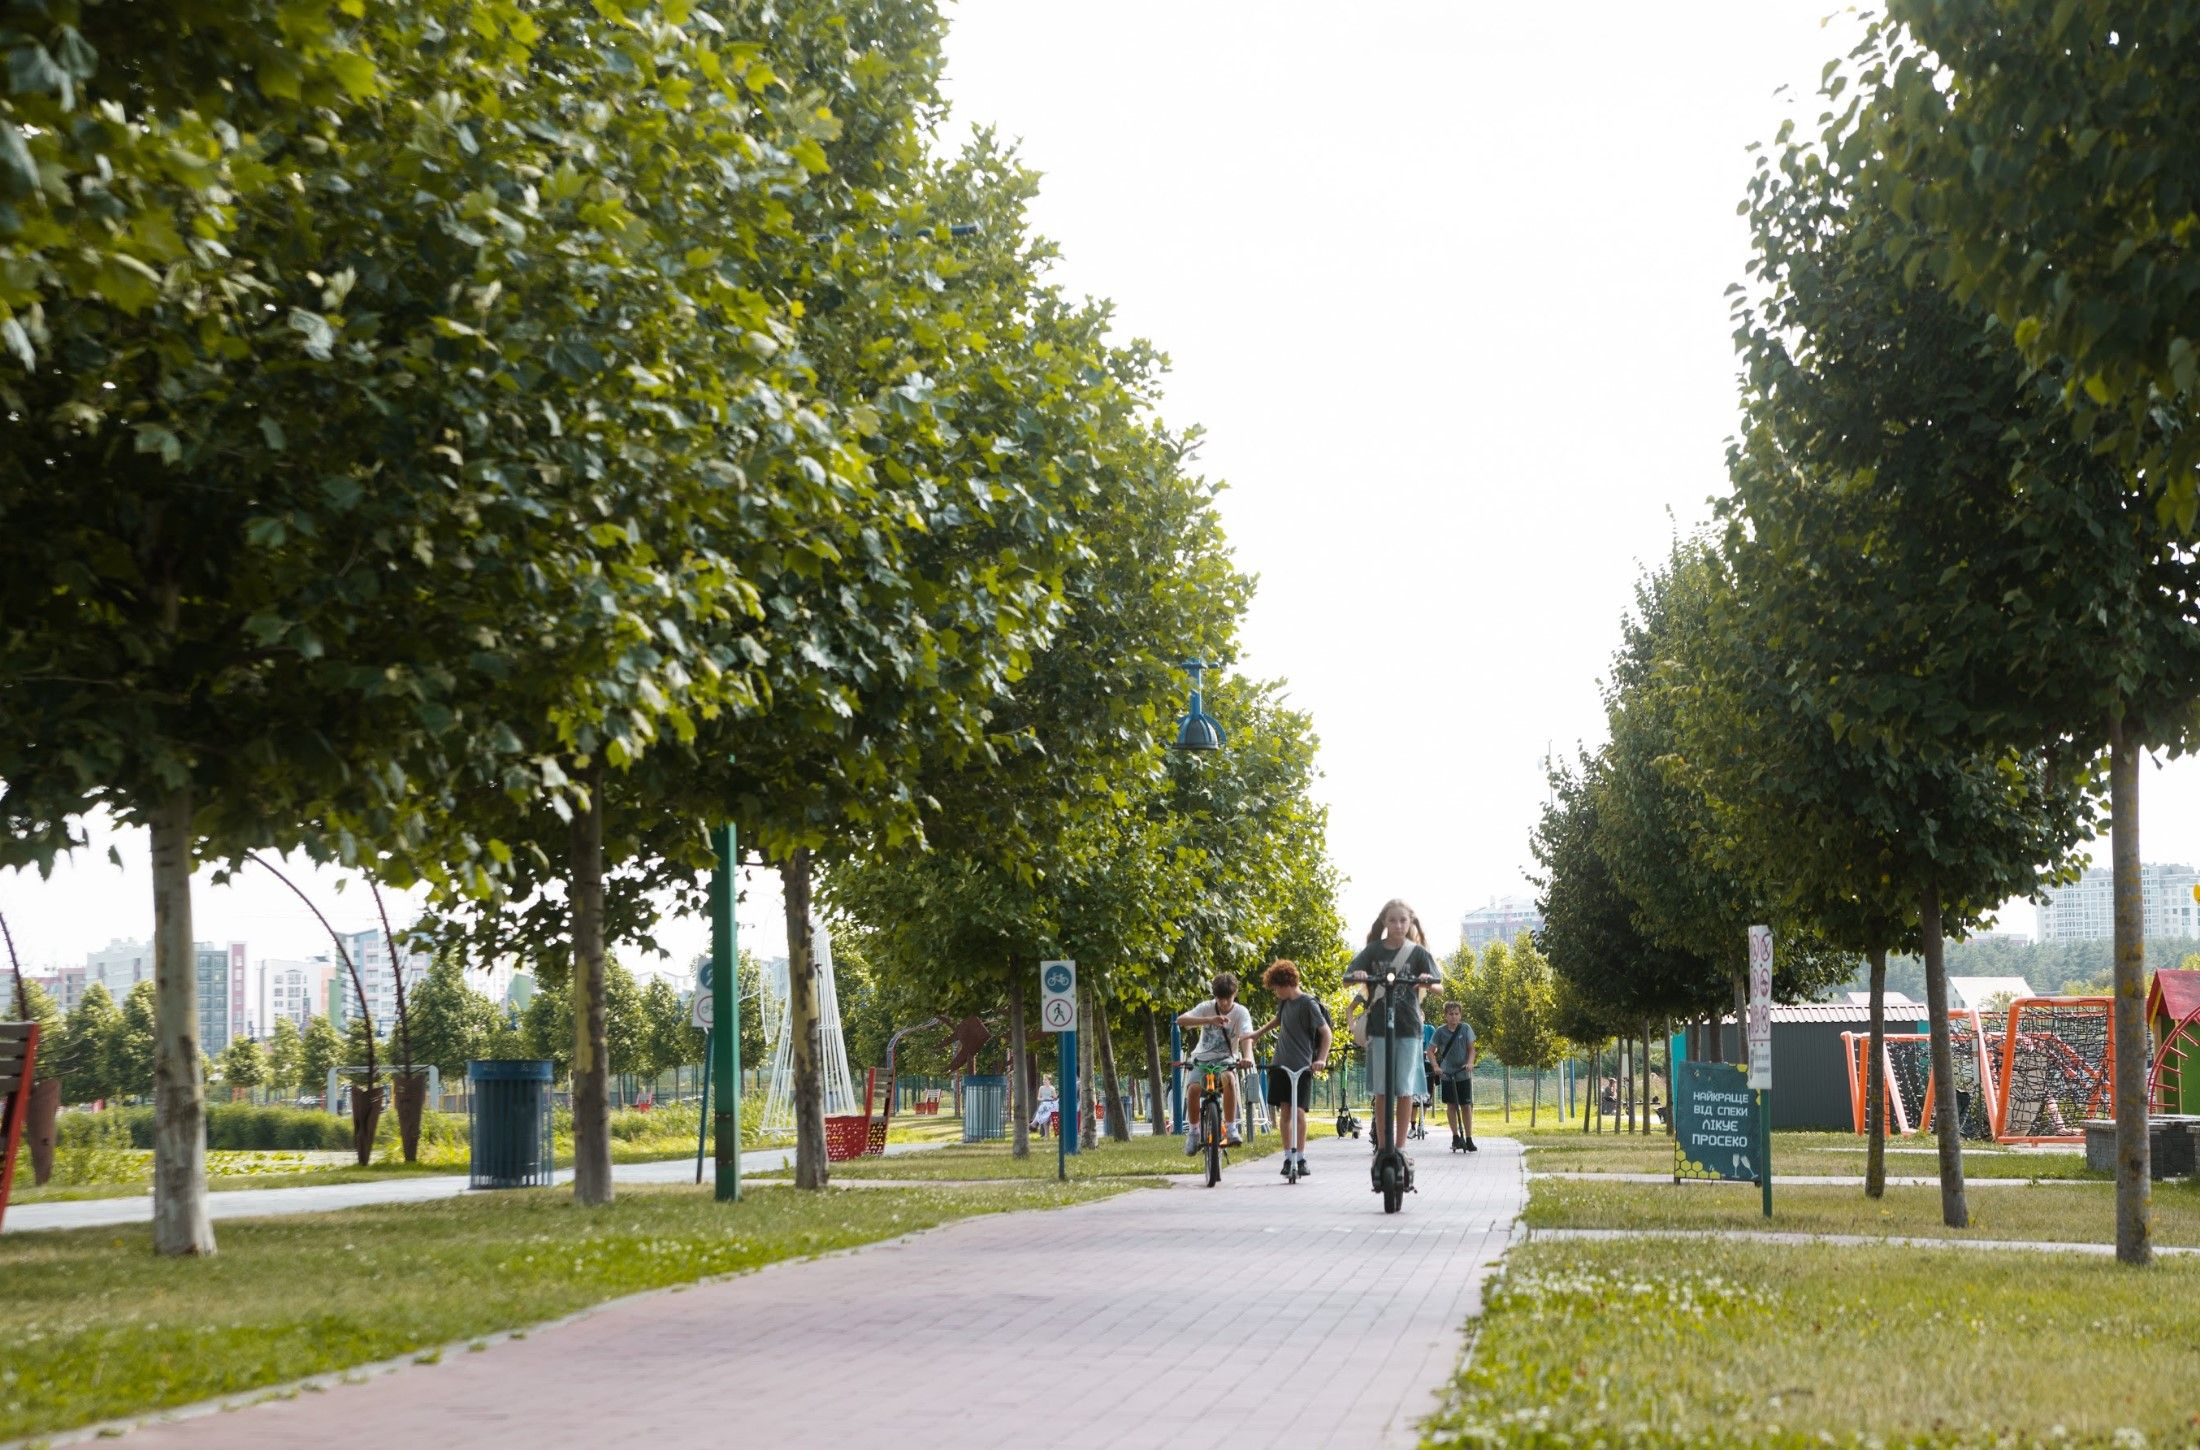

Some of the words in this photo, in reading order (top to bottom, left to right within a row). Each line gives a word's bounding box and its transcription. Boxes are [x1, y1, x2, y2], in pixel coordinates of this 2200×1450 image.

[1693, 1091, 1749, 1104] НАЙКРАЩЕ
[1693, 1105, 1713, 1116] ВІД
[1717, 1106, 1748, 1116] СПЕКИ
[1702, 1119, 1739, 1132] ЛІКУЄ
[1692, 1133, 1748, 1148] ПРОСЕКО
